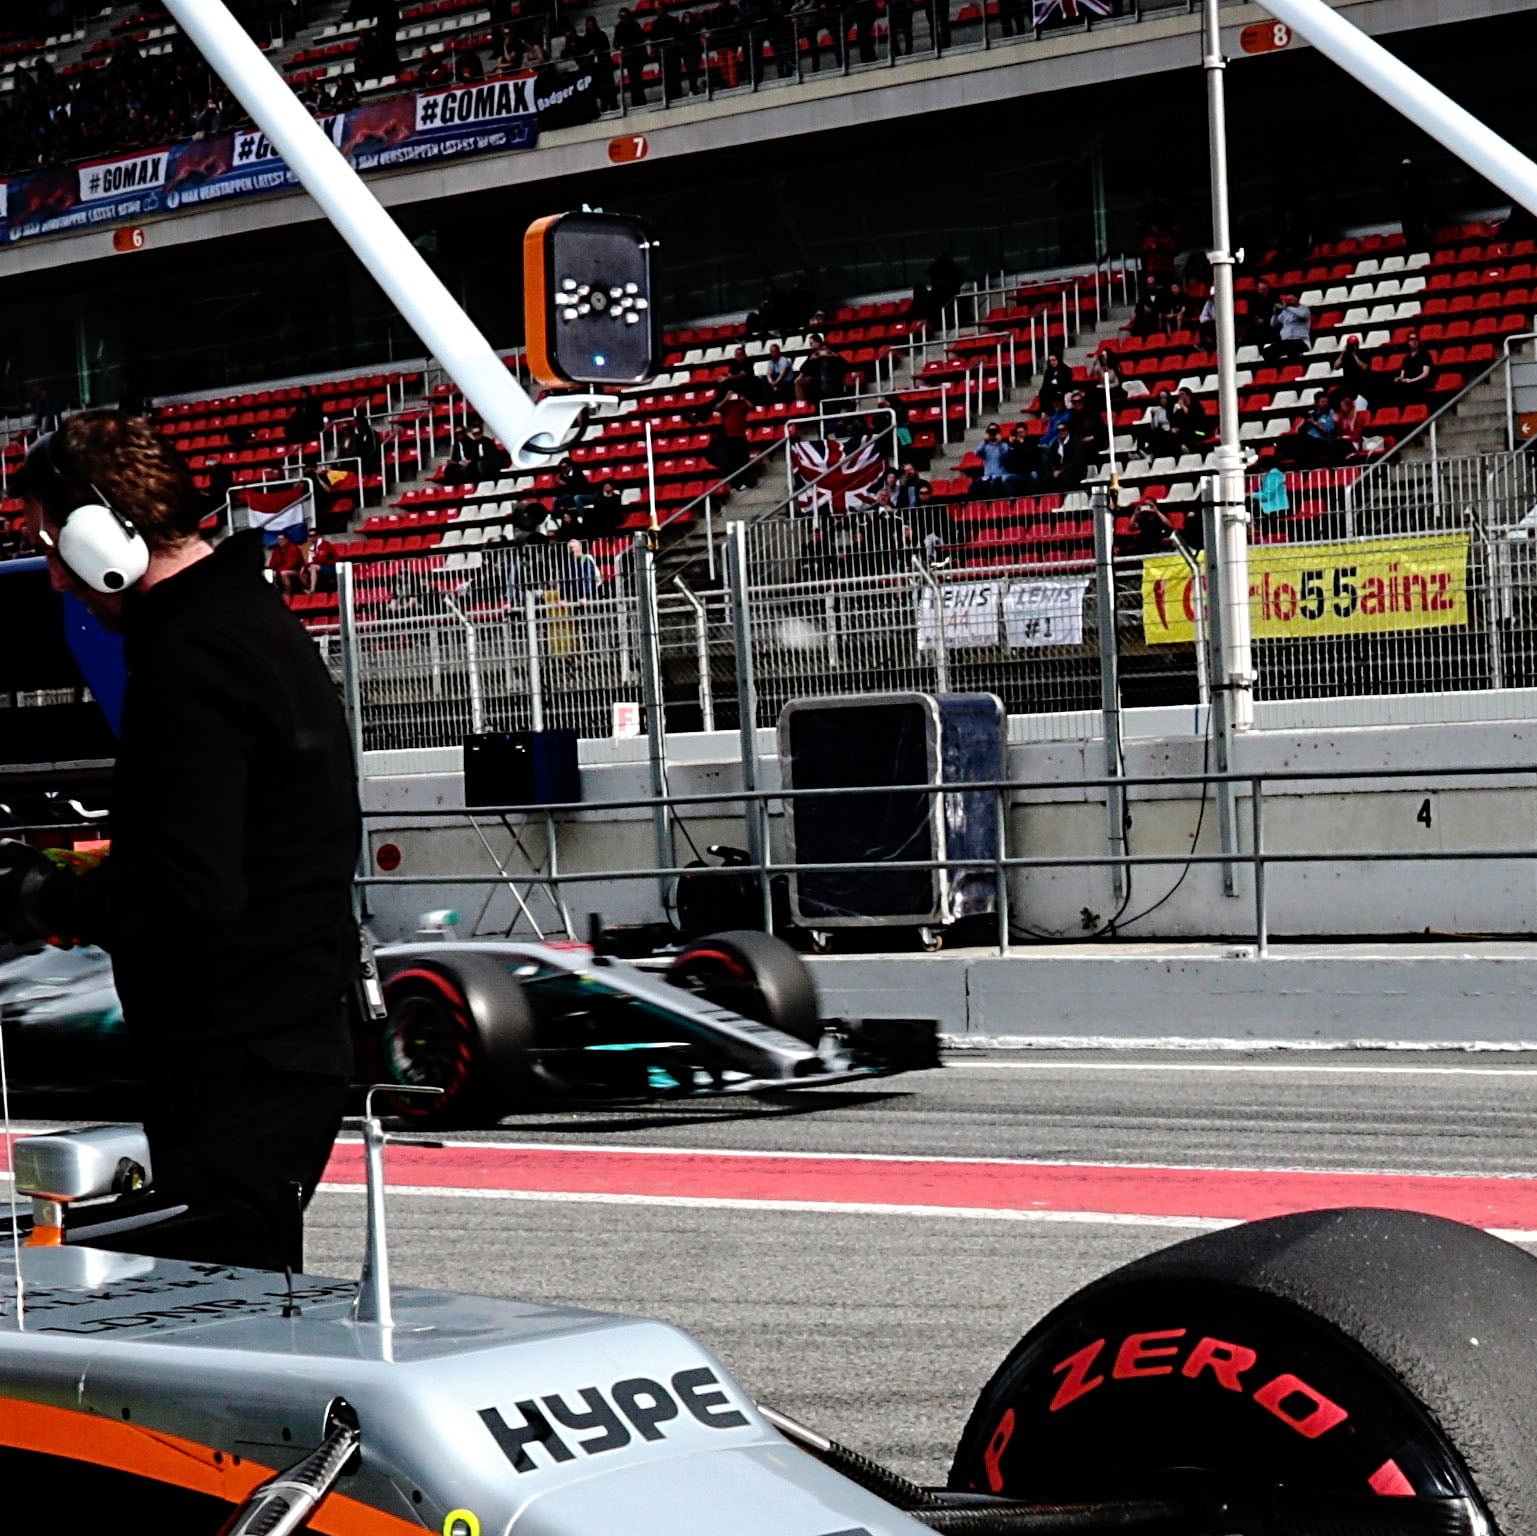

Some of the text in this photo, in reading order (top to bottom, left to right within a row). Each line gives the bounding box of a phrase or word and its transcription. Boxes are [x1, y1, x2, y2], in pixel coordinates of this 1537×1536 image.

[1273, 23, 1289, 47] 8
[421, 80, 530, 125] #GOMAX
[633, 137, 644, 158] 7
[88, 156, 162, 193] #GOMAX
[132, 229, 143, 247] 6
[1416, 798, 1432, 828] 4
[1049, 1327, 1350, 1439] ZERO
[478, 1366, 751, 1472] HYPE
